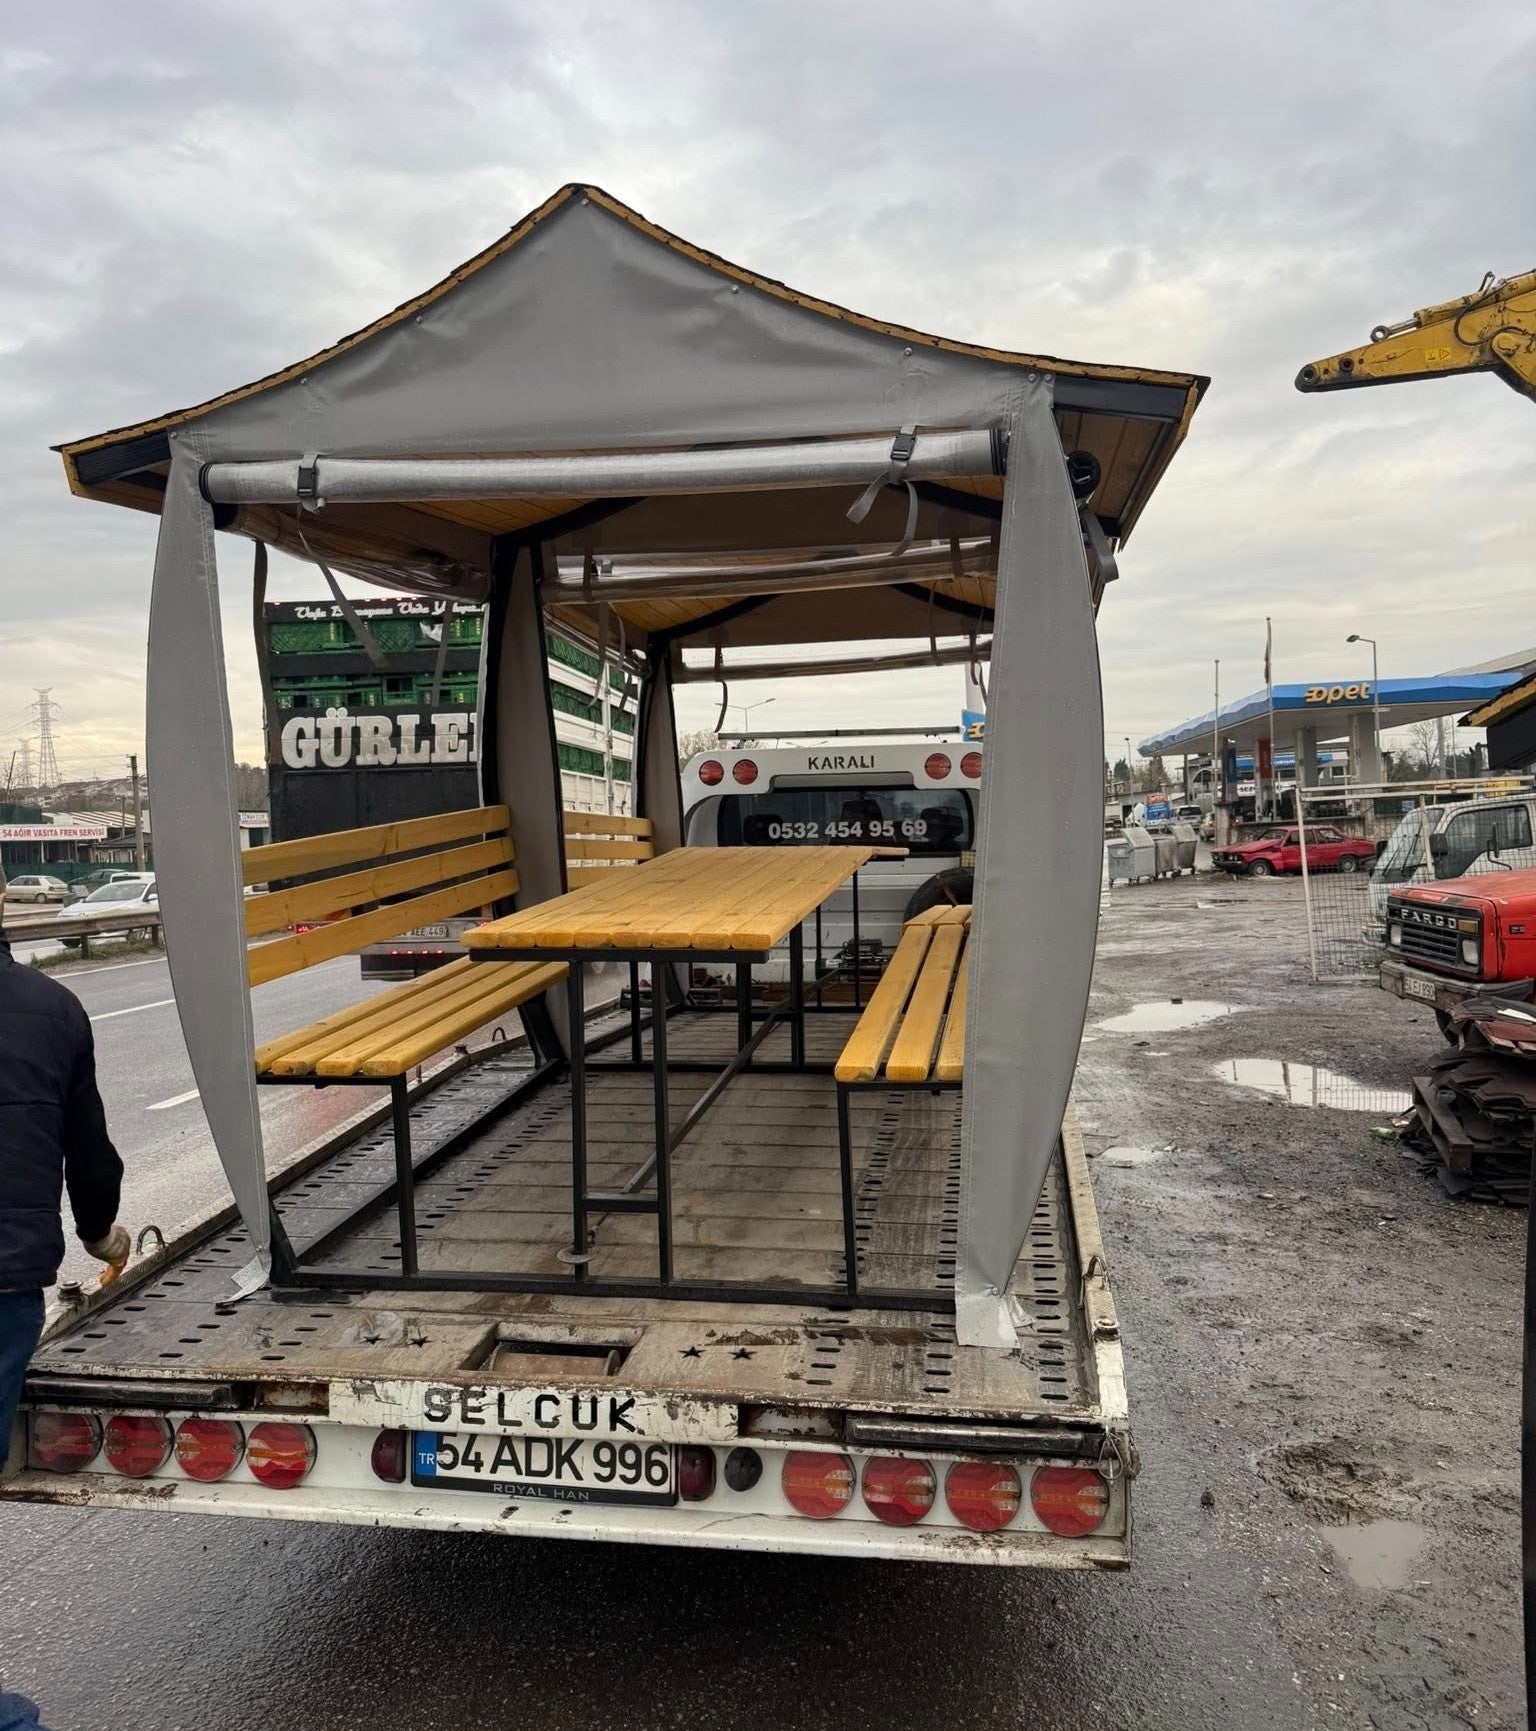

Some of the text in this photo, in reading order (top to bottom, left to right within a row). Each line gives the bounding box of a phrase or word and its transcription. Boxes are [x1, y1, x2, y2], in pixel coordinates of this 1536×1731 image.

[281, 707, 478, 769] GÜRLE
[808, 755, 875, 770] KARALI
[2, 830, 12, 838] 54
[33, 829, 59, 837] VASITA
[60, 828, 78, 837] FREN
[768, 818, 928, 839] 0532 454 95 69
[1401, 909, 1457, 929] FARGO
[424, 1387, 636, 1432] SELCUK
[419, 1432, 669, 1487] TR 54 ADK 996
[494, 1483, 590, 1501] ROYAL HAN
